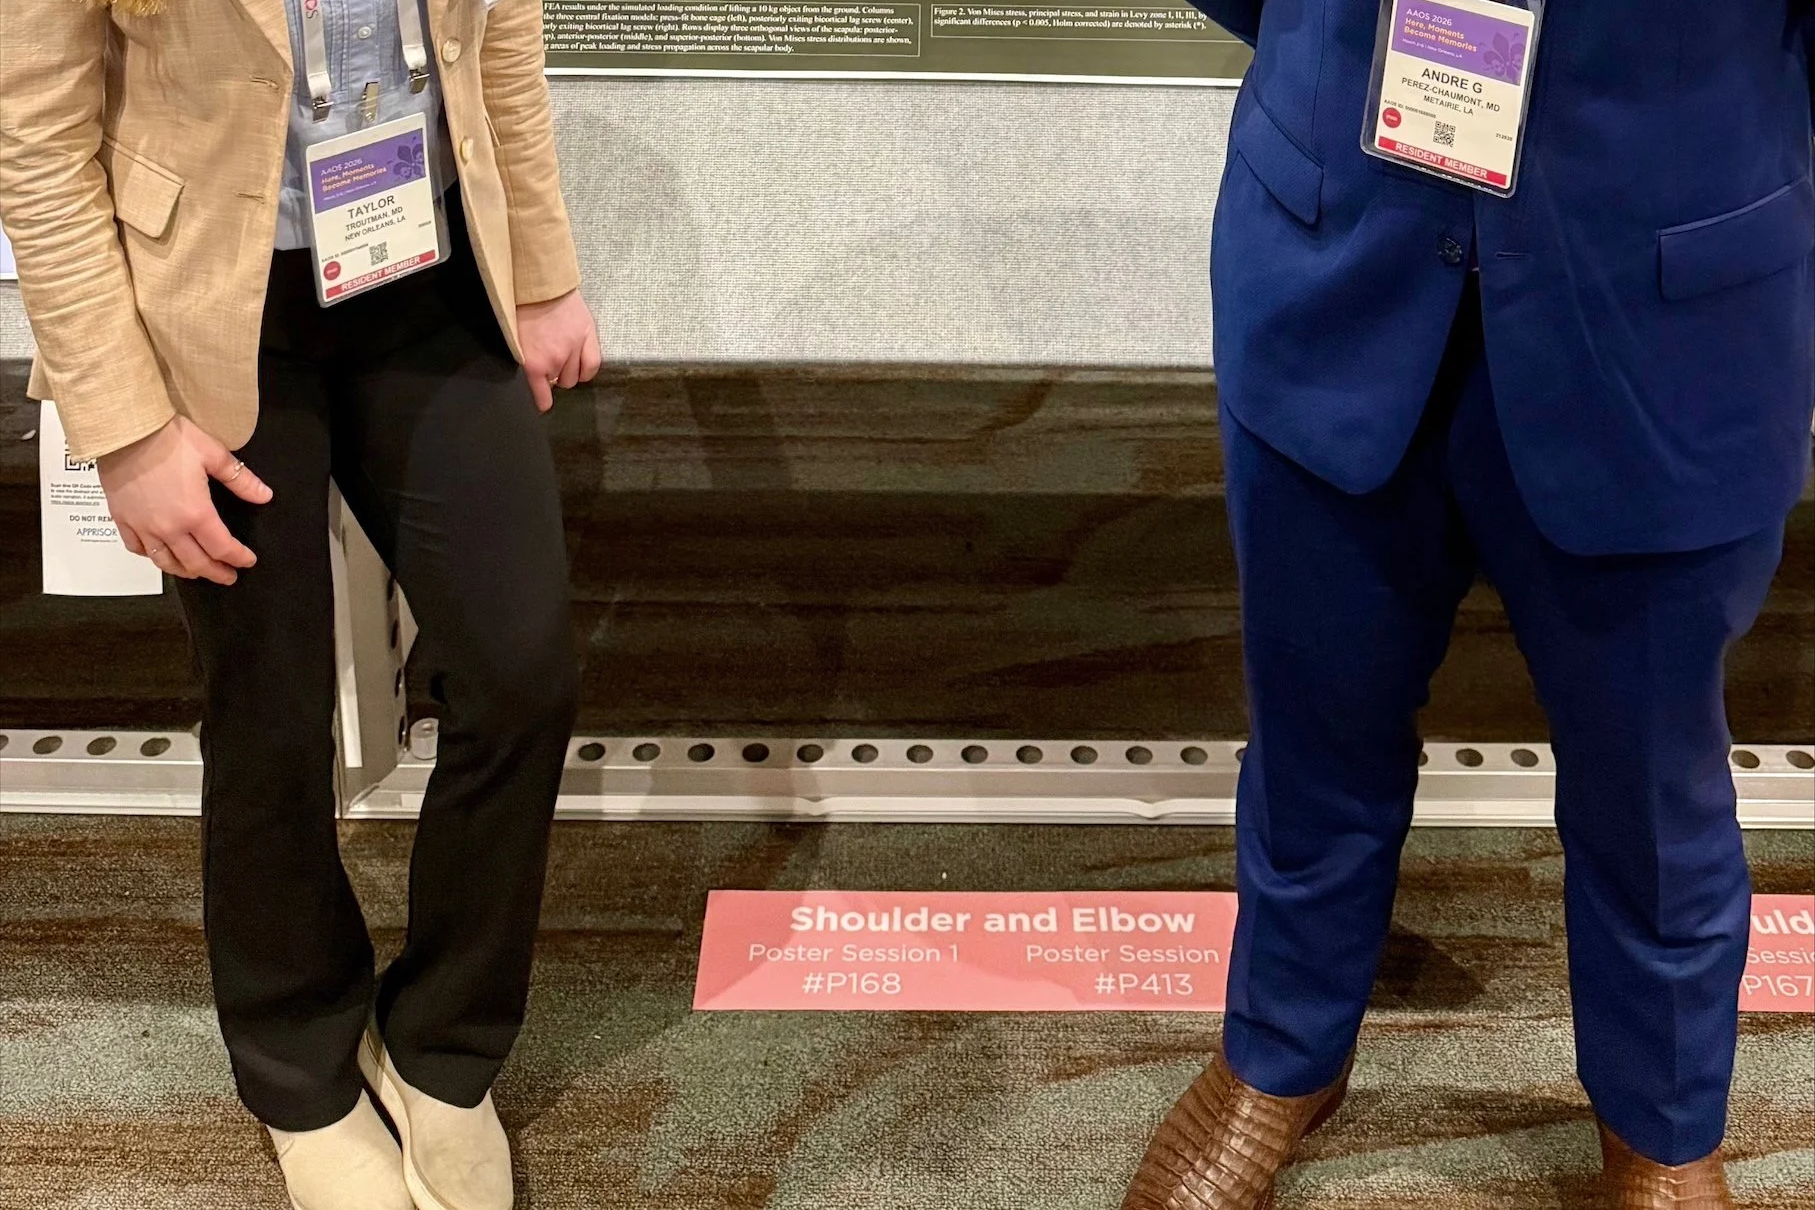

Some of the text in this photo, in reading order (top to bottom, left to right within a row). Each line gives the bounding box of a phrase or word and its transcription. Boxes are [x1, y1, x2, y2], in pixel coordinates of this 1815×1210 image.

[934, 8, 957, 17] Figure
[983, 8, 1004, 16] Mises
[1006, 9, 1027, 17] stress,
[1029, 9, 1060, 18] principal
[1061, 10, 1083, 18] stress,
[1085, 10, 1098, 18] and
[1100, 10, 1119, 18] strain
[1130, 11, 1147, 19] Levy
[1199, 11, 1207, 21] by
[934, 17, 971, 26] significant
[972, 18, 1011, 26] differences
[1053, 19, 1072, 27] Holm
[1074, 20, 1110, 28] corrected)
[1154, 21, 1163, 30] by
[1165, 21, 1192, 29] asterisk
[1406, 8, 1452, 26] AAOS 2026
[1404, 26, 1436, 41] Become
[1438, 35, 1477, 52] Memories
[1405, 18, 1464, 39] Here, Moments
[1421, 67, 1483, 94] ANDRE G
[1401, 77, 1484, 109] PEREZ-CHAUMONT,
[1486, 100, 1501, 112] MD
[1423, 95, 1461, 115] METAIRIE,
[1463, 105, 1474, 116] LA
[1395, 143, 1488, 179] RESIDENT MEMBER
[345, 206, 403, 232] TROUTMAN, MD
[347, 195, 395, 219] TAYLOR
[345, 215, 406, 241] NEW ORLEANS, LA
[341, 255, 421, 292] RESIDENT MEMBER
[77, 528, 117, 536] APPRISOR
[790, 906, 1196, 933] Shoulder and Elbow
[748, 944, 959, 963] Poster Session 1
[1026, 945, 1220, 963] Poster Session
[802, 972, 902, 995] #P168
[1093, 972, 1194, 996] #P413
